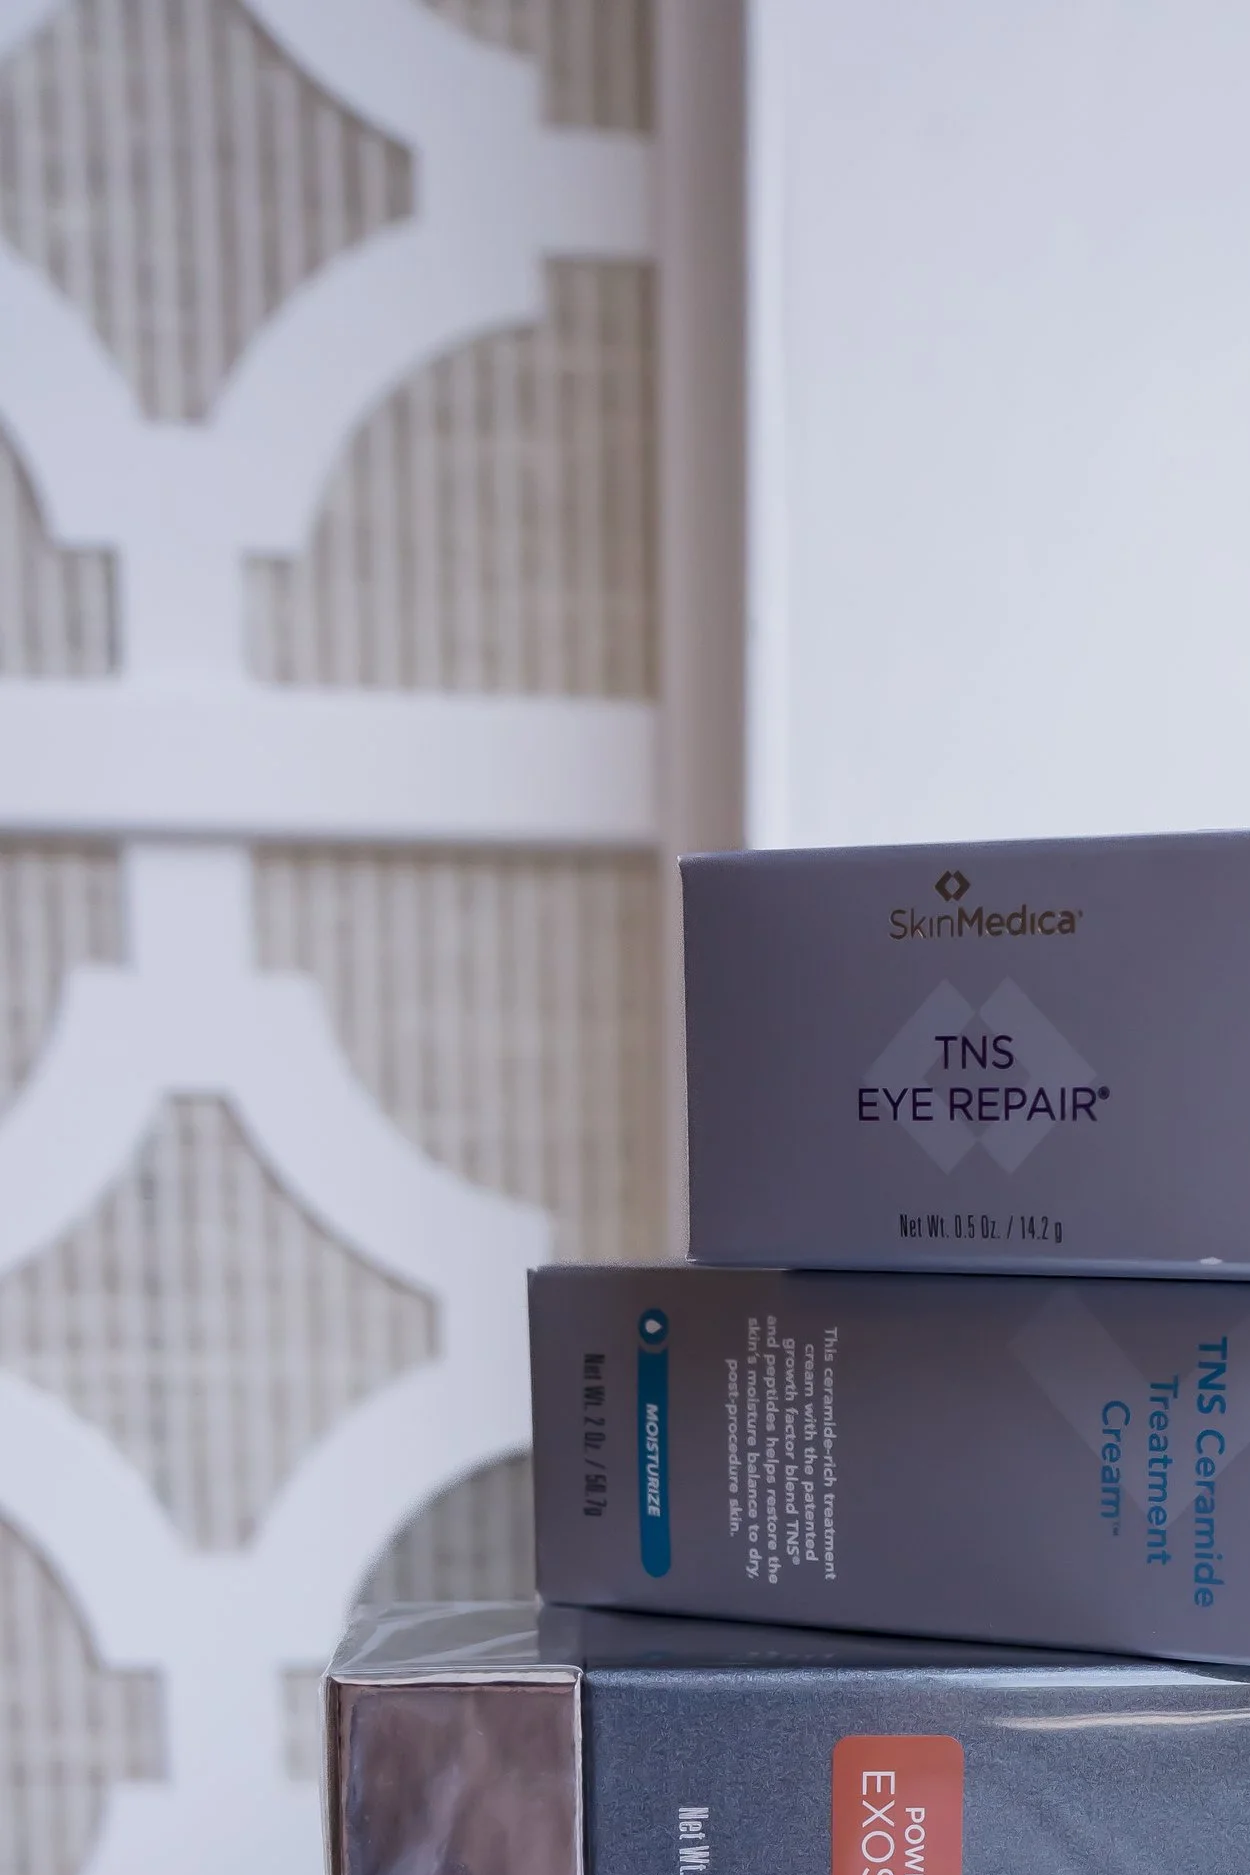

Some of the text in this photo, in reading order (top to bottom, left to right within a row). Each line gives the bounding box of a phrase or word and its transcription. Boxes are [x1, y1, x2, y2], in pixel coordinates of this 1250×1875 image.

[935, 1035, 1014, 1070] TNS
[858, 1087, 933, 1122] EYE
[900, 1215, 922, 1238] Net
[926, 1215, 949, 1239] Wt.
[954, 1215, 977, 1239] 0.5
[980, 1216, 1000, 1239] Oz.
[1020, 1216, 1049, 1241] 14.2
[1054, 1221, 1064, 1244] g
[583, 1353, 605, 1380] Net
[783, 1338, 796, 1402] growth
[584, 1418, 605, 1427] 2
[747, 1369, 760, 1447] moisture
[785, 1406, 799, 1460] factor
[646, 1403, 660, 1518] MOISTURIZE
[725, 1358, 743, 1537] post-procedure skin.
[763, 1315, 782, 1585] and peptides helps restore the
[802, 1343, 818, 1562] cream with the patented
[823, 1326, 838, 1581] This ceramide-rich treatment
[1146, 1374, 1179, 1566] Treatment
[1193, 1335, 1228, 1608] TNS Ceramide
[747, 1452, 760, 1519] balance
[785, 1464, 799, 1515] blend
[748, 1525, 760, 1543] to
[746, 1548, 762, 1580] dry,
[678, 1807, 709, 1840] Net
